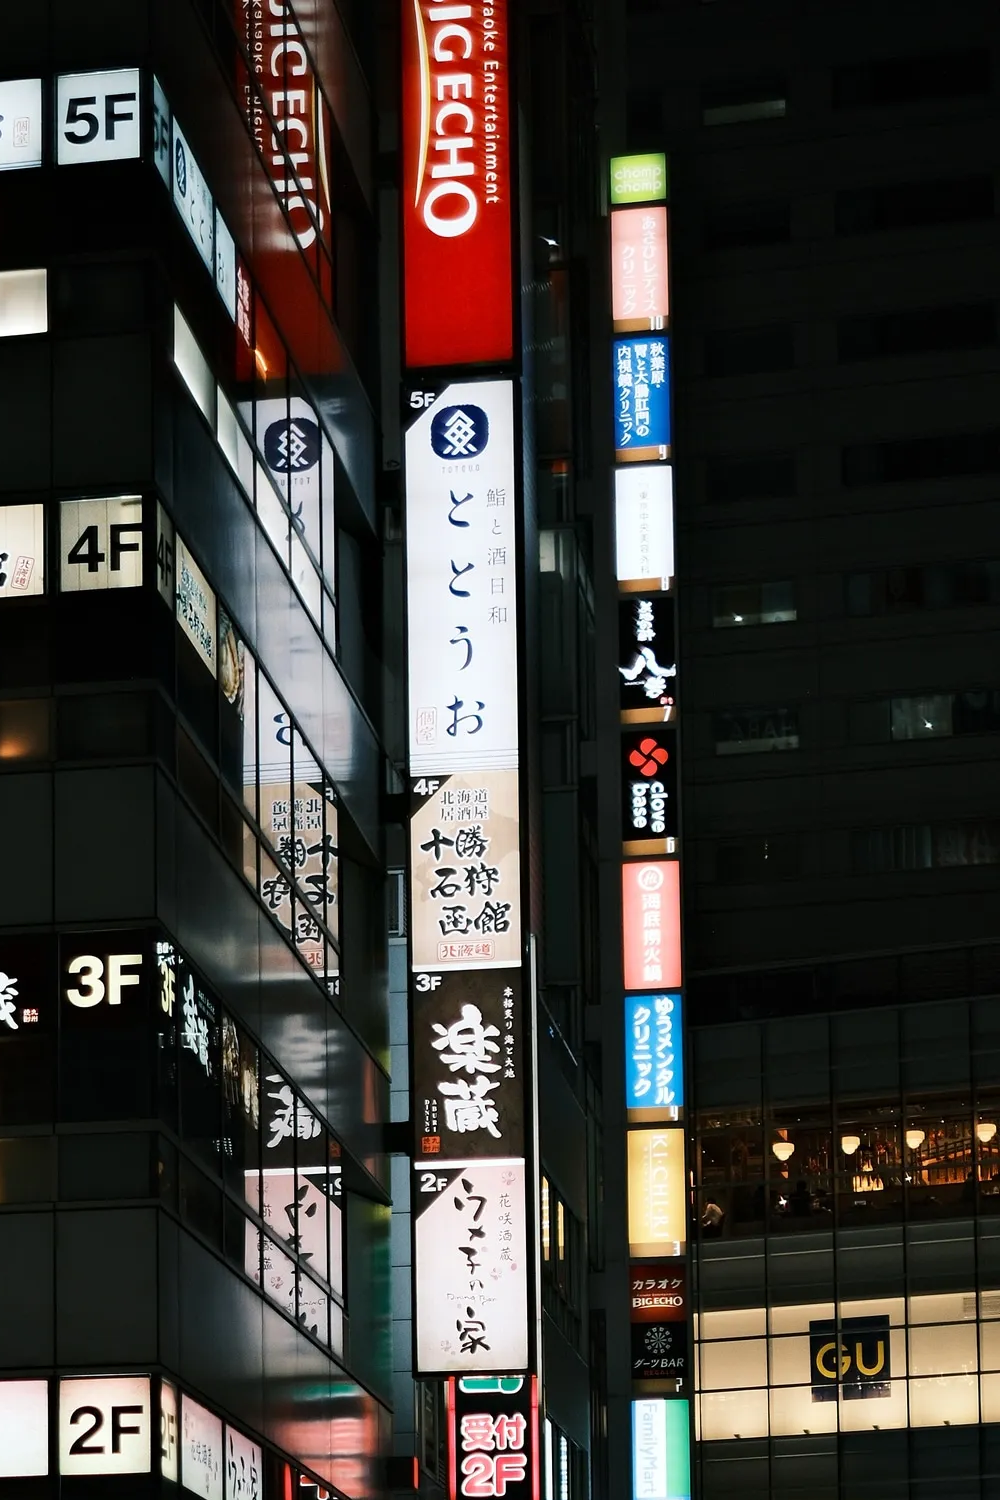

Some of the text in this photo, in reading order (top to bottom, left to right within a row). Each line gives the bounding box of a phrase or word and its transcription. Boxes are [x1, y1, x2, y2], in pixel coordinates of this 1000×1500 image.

[429, 0, 473, 62] IG
[63, 92, 137, 145] 5F
[483, 60, 500, 204] Entertainment
[410, 391, 436, 409] 5F
[67, 522, 143, 573] 4F
[445, 489, 486, 737] ととうお
[413, 779, 440, 796] 4F
[440, 788, 489, 804] 北海道
[631, 782, 650, 829] base
[650, 780, 669, 833] clove
[440, 805, 490, 822] 居酒屋
[420, 824, 489, 863] 十勝
[430, 865, 500, 899] 石狩
[439, 901, 511, 936] 函館
[67, 954, 143, 1008] 3F
[416, 974, 442, 991] 3F
[431, 1003, 502, 1138] 楽蔵
[632, 1006, 652, 1097] クリニック
[654, 996, 676, 1105] ゆうメンタル
[420, 1173, 448, 1193] 2F
[498, 1192, 514, 1263] 花咲酒蔵
[632, 1279, 683, 1290] カラオケ
[816, 1341, 885, 1379] GU
[69, 1404, 144, 1456] 2F
[460, 1412, 528, 1453] 受付
[639, 1402, 659, 1495] FamilyMart
[460, 1452, 528, 1498] 2F
